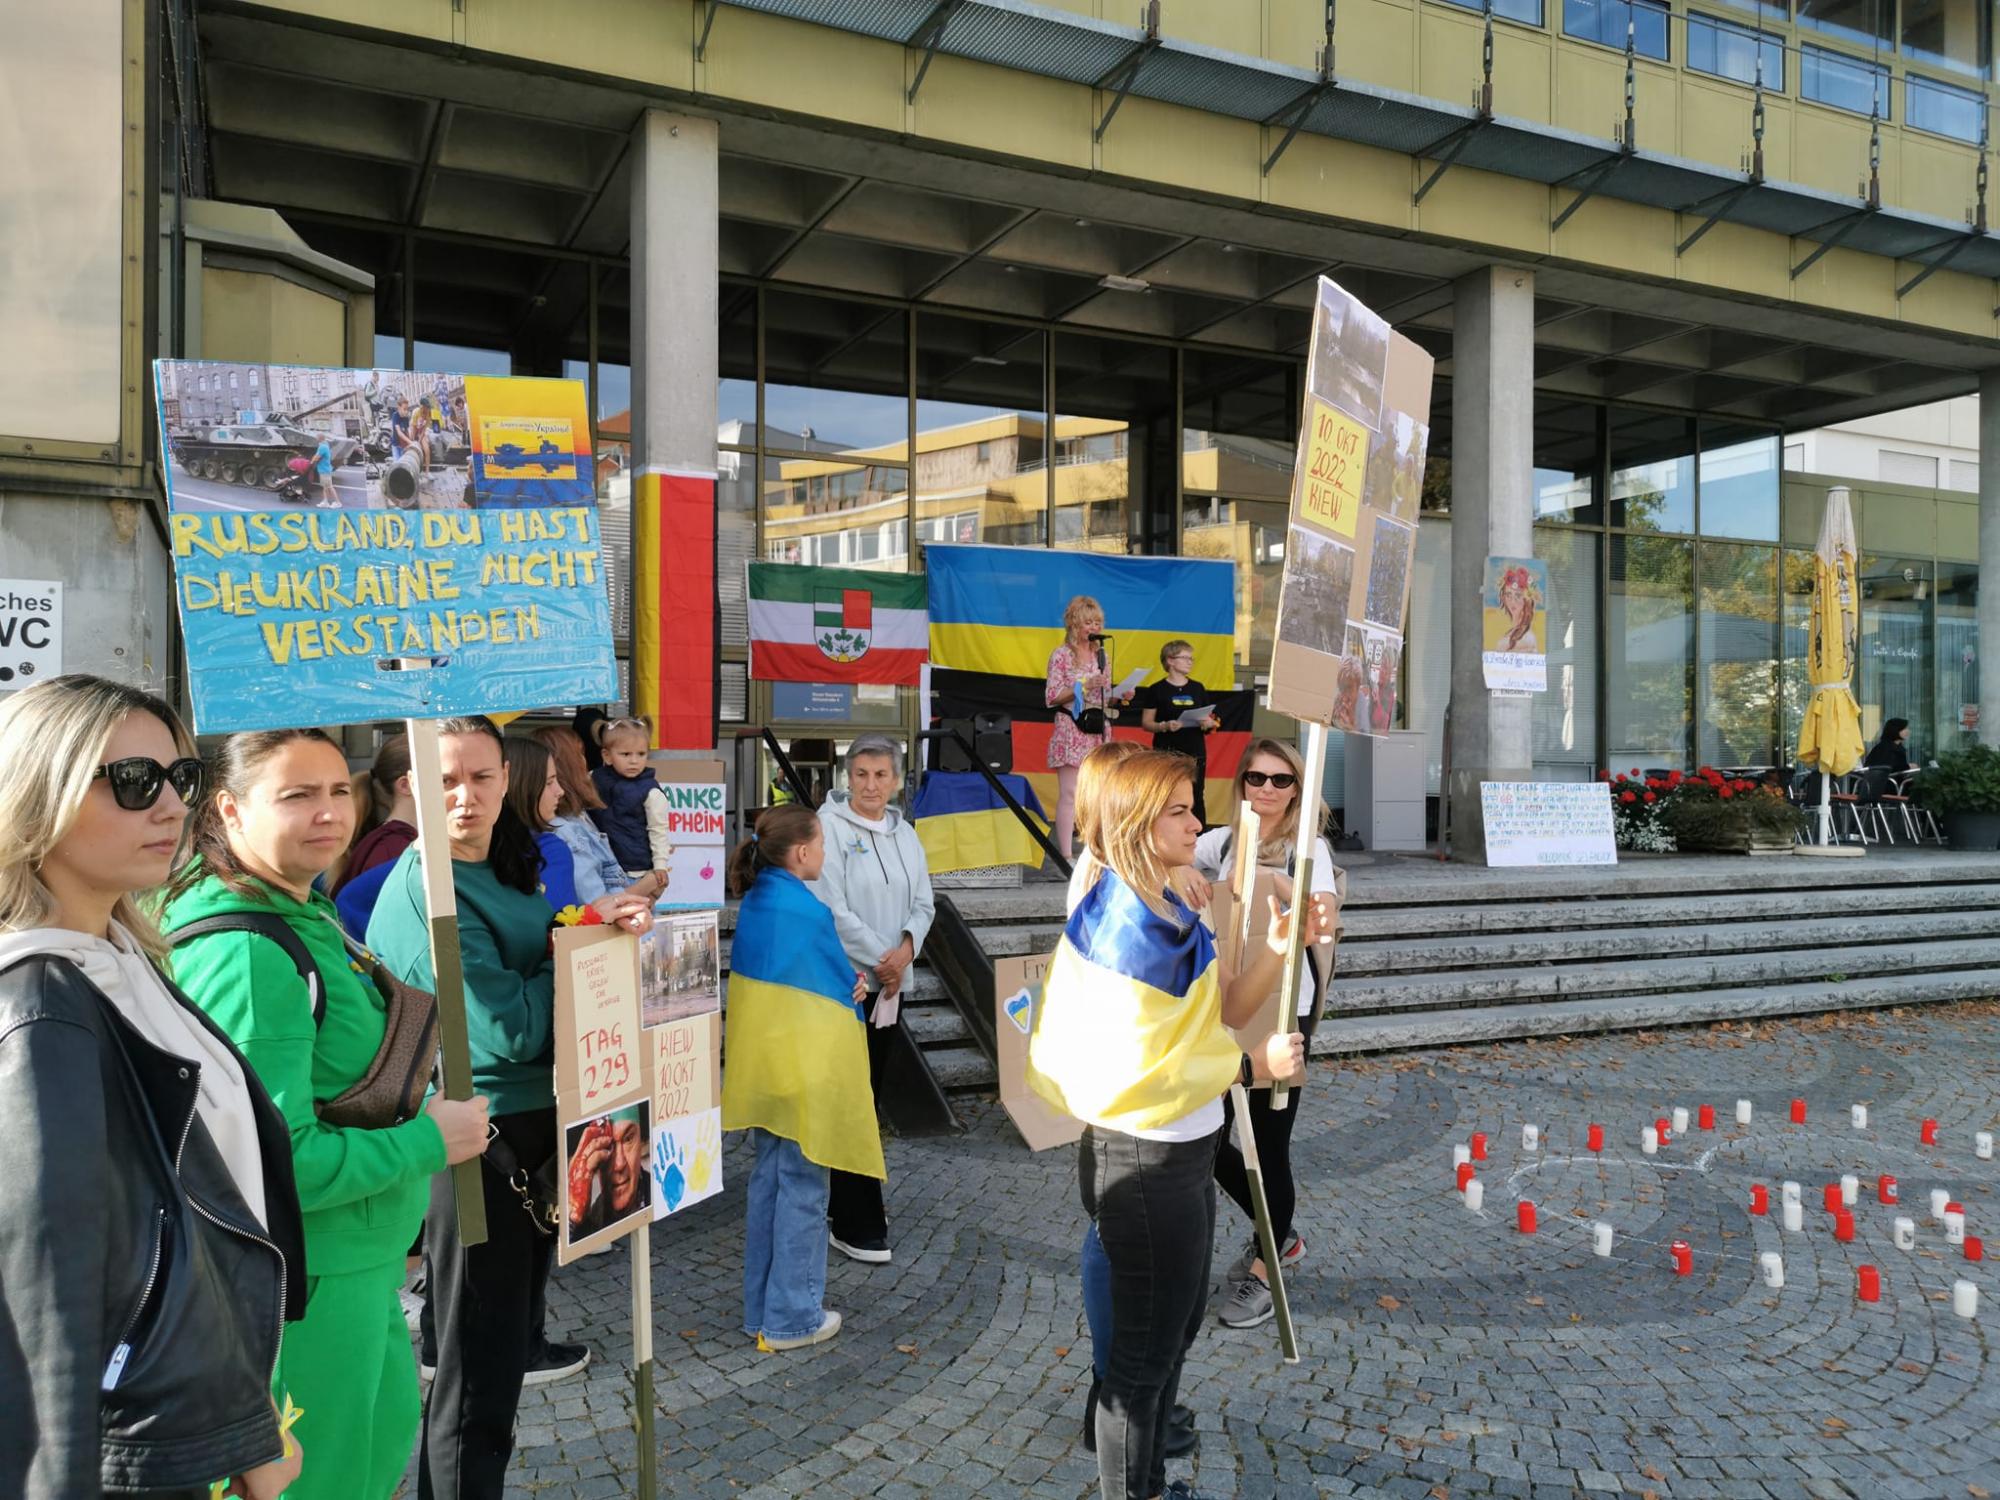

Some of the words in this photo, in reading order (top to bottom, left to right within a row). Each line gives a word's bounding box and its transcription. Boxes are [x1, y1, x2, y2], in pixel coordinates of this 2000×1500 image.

[1337, 427, 1359, 455] OKT
[1311, 447, 1346, 489] 2022
[1309, 483, 1342, 522] KIEW
[172, 513, 415, 559] RUSSLAND,
[422, 512, 484, 548] DU
[499, 507, 590, 543] HAST
[480, 550, 598, 588] NICHT
[261, 603, 540, 665] VERSTANDEN
[662, 786, 722, 810] ANKe
[579, 1022, 622, 1059] TAG
[660, 1027, 694, 1057] KIEW
[584, 1052, 629, 1098] 229
[657, 1087, 689, 1120] 2022
